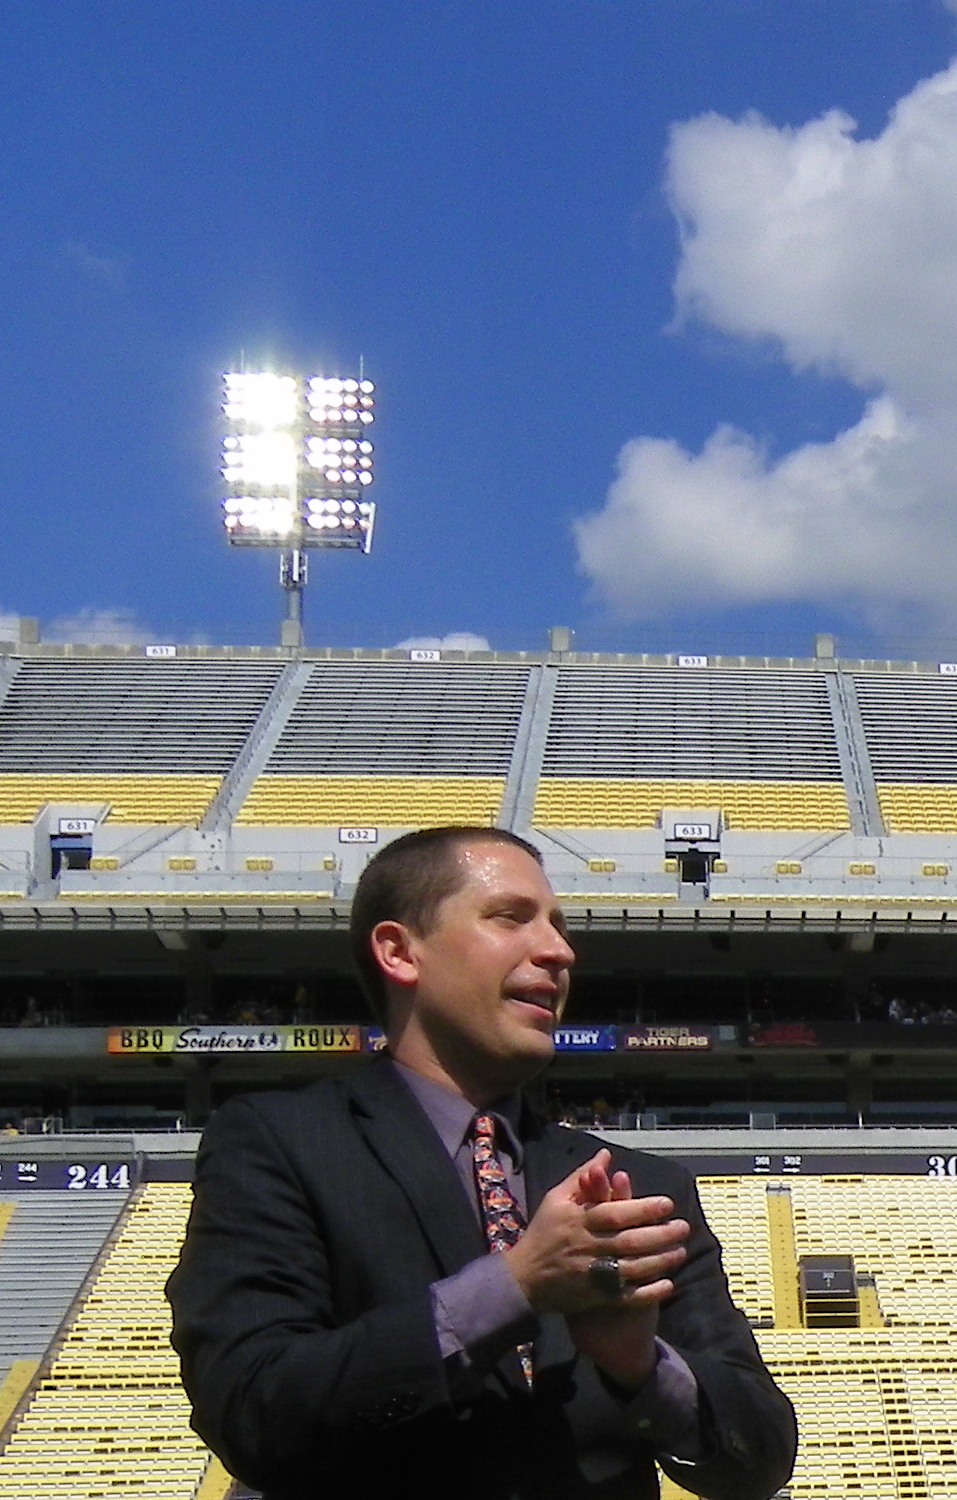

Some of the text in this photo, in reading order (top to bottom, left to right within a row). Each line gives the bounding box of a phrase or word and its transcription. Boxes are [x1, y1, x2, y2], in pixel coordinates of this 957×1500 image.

[416, 651, 435, 660] 632
[66, 821, 88, 831] 631
[682, 826, 704, 836] 633
[347, 830, 370, 840] 632
[645, 1027, 690, 1037] TIGER
[120, 1030, 163, 1049] BBQ
[176, 1028, 257, 1050] Southern
[294, 1029, 351, 1048] ROUX
[627, 1036, 709, 1047] PARTNERS
[67, 1164, 131, 1190] 244
